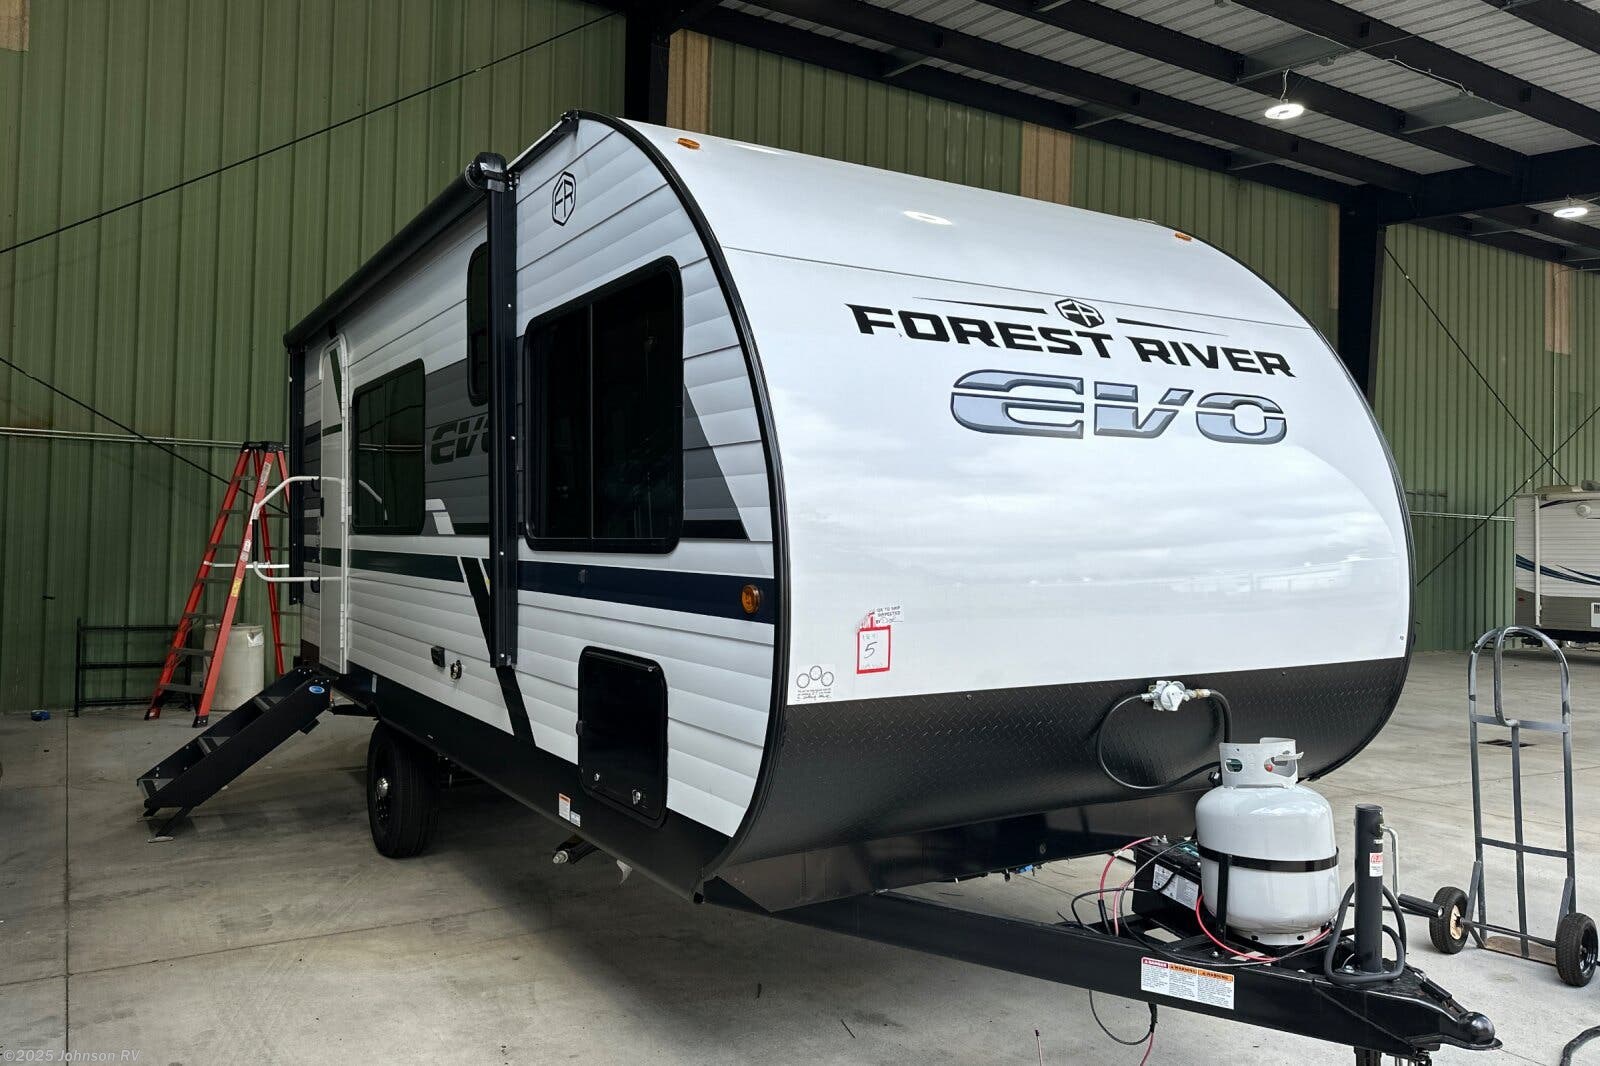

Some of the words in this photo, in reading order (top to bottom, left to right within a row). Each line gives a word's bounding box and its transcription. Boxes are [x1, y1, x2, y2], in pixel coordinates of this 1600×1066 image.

[554, 177, 574, 219] FR
[1056, 299, 1103, 328] FR
[845, 303, 1113, 358] FOREST
[1126, 335, 1296, 378] RIVER
[950, 368, 1288, 445] EVO
[864, 641, 878, 659] 5
